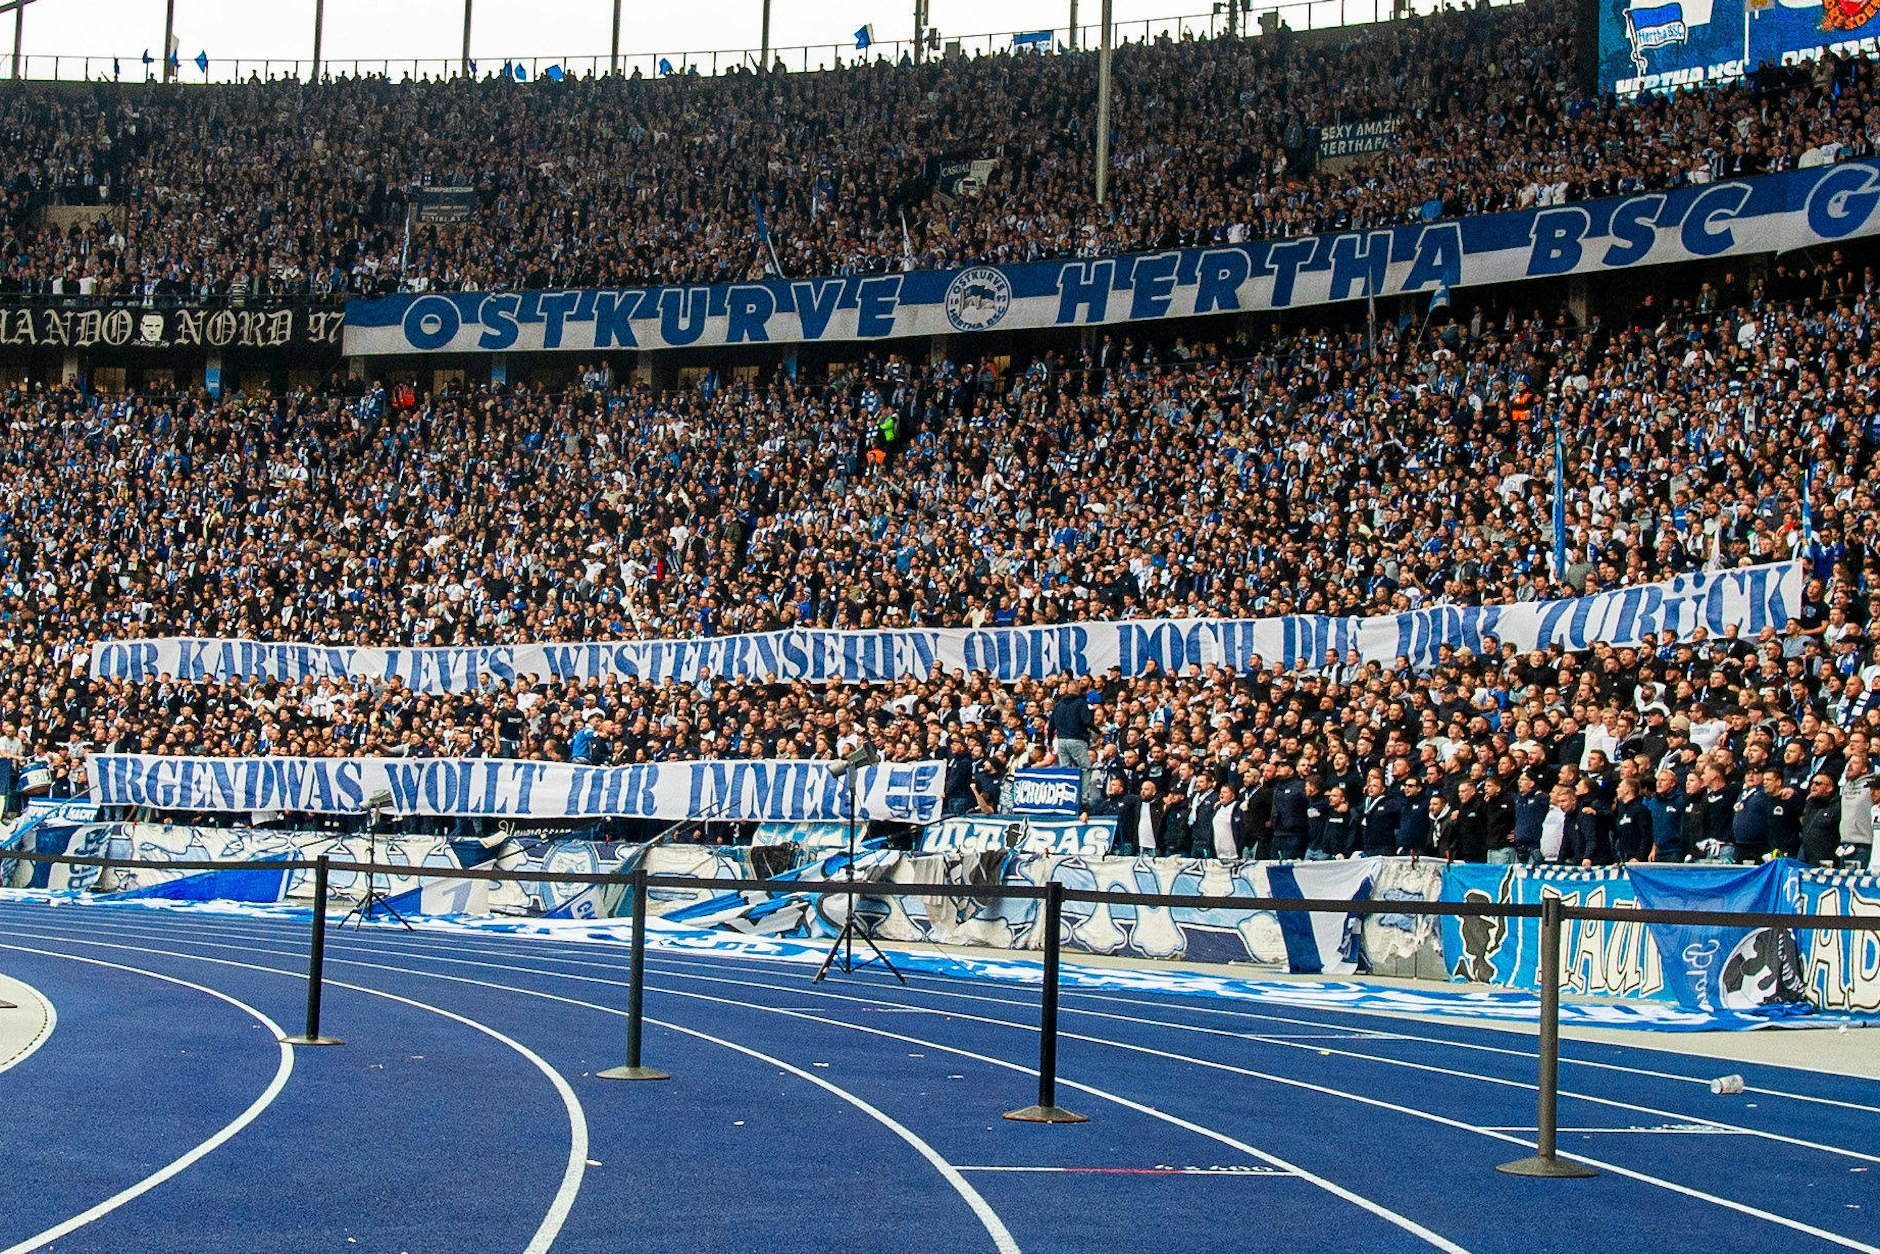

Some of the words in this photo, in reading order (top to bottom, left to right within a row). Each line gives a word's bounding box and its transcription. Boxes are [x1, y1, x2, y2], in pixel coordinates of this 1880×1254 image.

[1321, 124, 1353, 140] SEXY
[402, 272, 904, 352] OSTKURVE
[1056, 222, 1462, 324] HERTHA
[1525, 183, 1753, 276] BSC
[953, 270, 1007, 295] OSTKURVE
[174, 308, 292, 346] NORD
[99, 643, 159, 682] OB
[543, 630, 940, 686] WESTFERNSEHEN
[963, 626, 1091, 681] ODER
[1117, 621, 1256, 676] DOCH
[1281, 615, 1364, 671] DIE
[1396, 606, 1501, 668] DDR
[95, 757, 363, 812] IRGENDWAS
[384, 760, 548, 814] WOLLT
[564, 763, 660, 816] IHR
[923, 822, 1111, 855] ULTRAS
